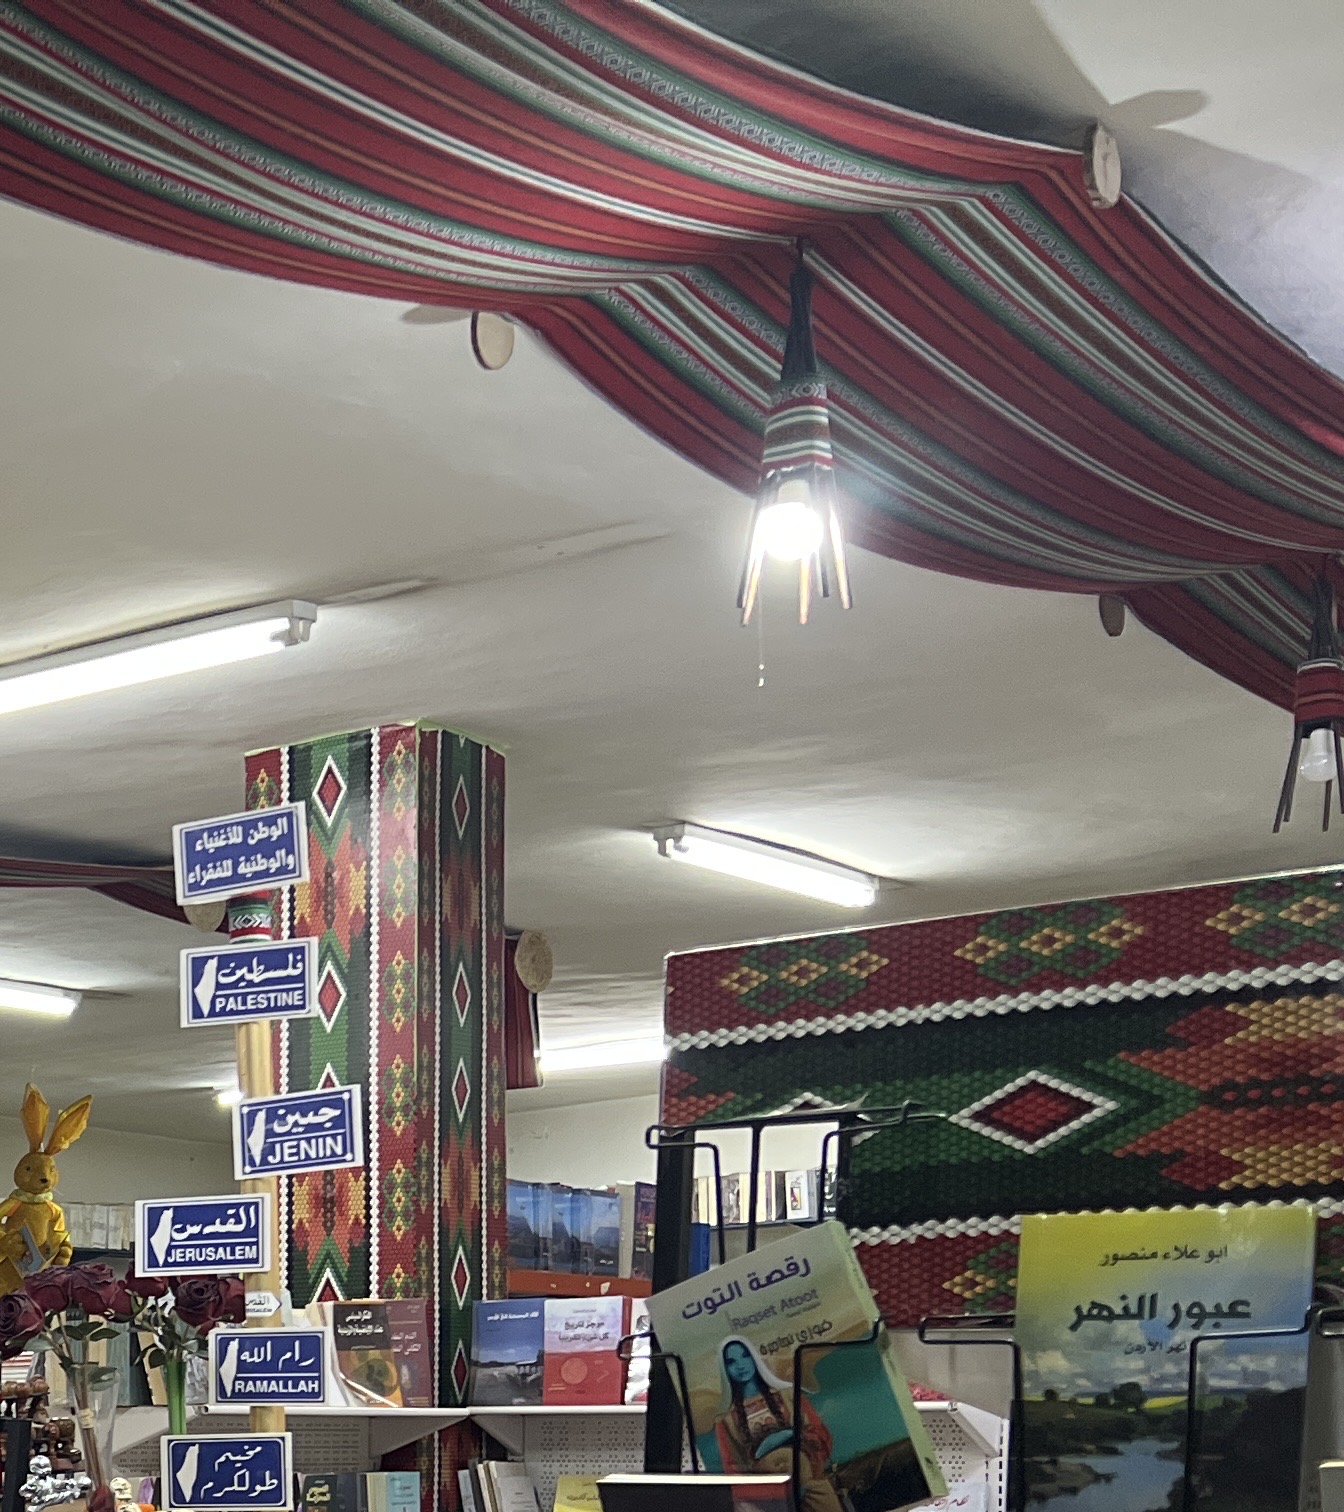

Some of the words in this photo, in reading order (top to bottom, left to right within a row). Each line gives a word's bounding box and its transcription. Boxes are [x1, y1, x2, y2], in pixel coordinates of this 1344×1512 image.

[248, 816, 288, 843] الوطن
[187, 863, 232, 886] للفقراء
[238, 852, 295, 876] والوطنية
[217, 952, 304, 984] فلسطين
[216, 989, 304, 1012] PALESTINE
[273, 1103, 341, 1133] جنين
[267, 1136, 343, 1164] JENIN
[171, 1207, 255, 1237] القدس
[167, 1245, 257, 1263] JERUSALEM
[1098, 1248, 1159, 1267] منصور
[1162, 1245, 1200, 1260] علاء
[748, 1256, 812, 1294] رقصة
[682, 1277, 743, 1321] التوت
[731, 1302, 778, 1331] Raqset
[779, 1286, 820, 1315] Atoot
[1069, 1292, 1159, 1332] النهر
[1167, 1299, 1252, 1330] عبور
[240, 1339, 271, 1365] الله
[279, 1341, 316, 1370] رام
[234, 1379, 318, 1394] RAMALLAH
[214, 1444, 261, 1473] مخيم
[200, 1469, 278, 1499] طولكرم
